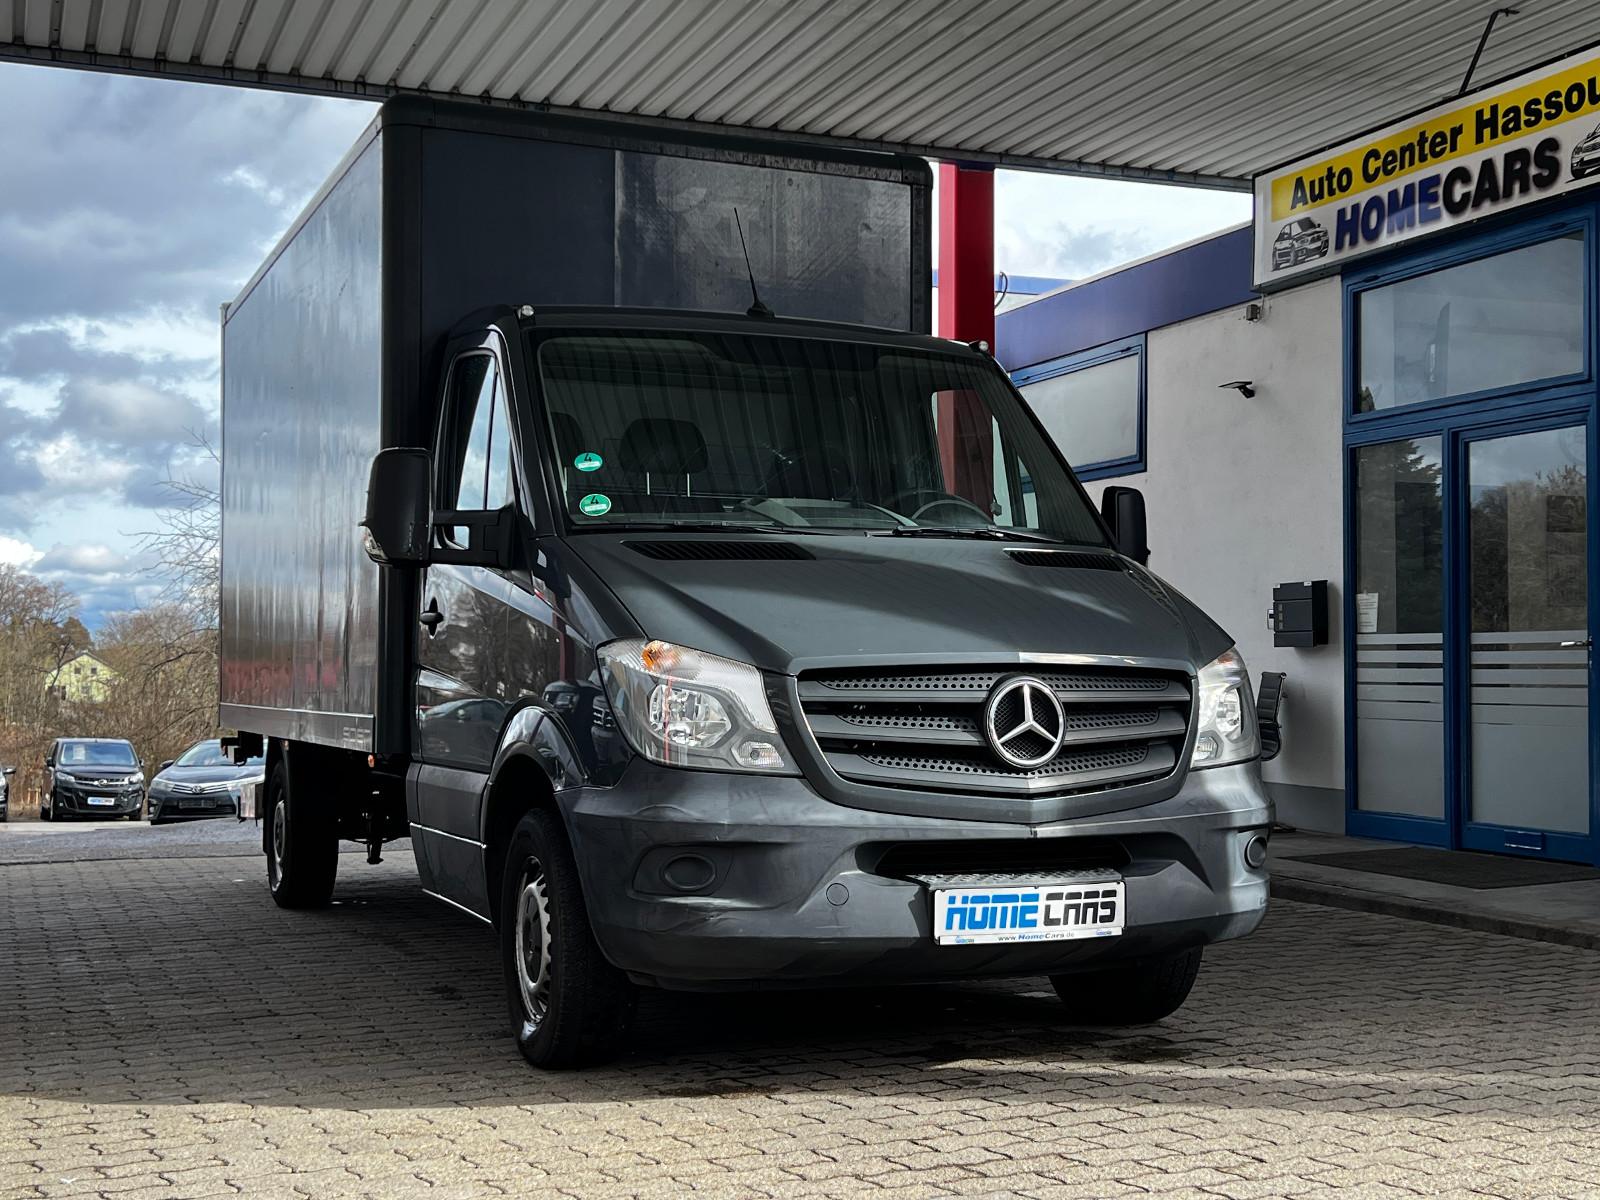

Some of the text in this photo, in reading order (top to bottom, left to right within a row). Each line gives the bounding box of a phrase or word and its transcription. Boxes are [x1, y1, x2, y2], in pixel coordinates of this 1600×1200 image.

[1290, 166, 1353, 210] Auto
[1362, 123, 1464, 184] Center
[584, 453, 592, 462] 4
[591, 496, 599, 504] 4
[945, 889, 1118, 931] HOME CARS
